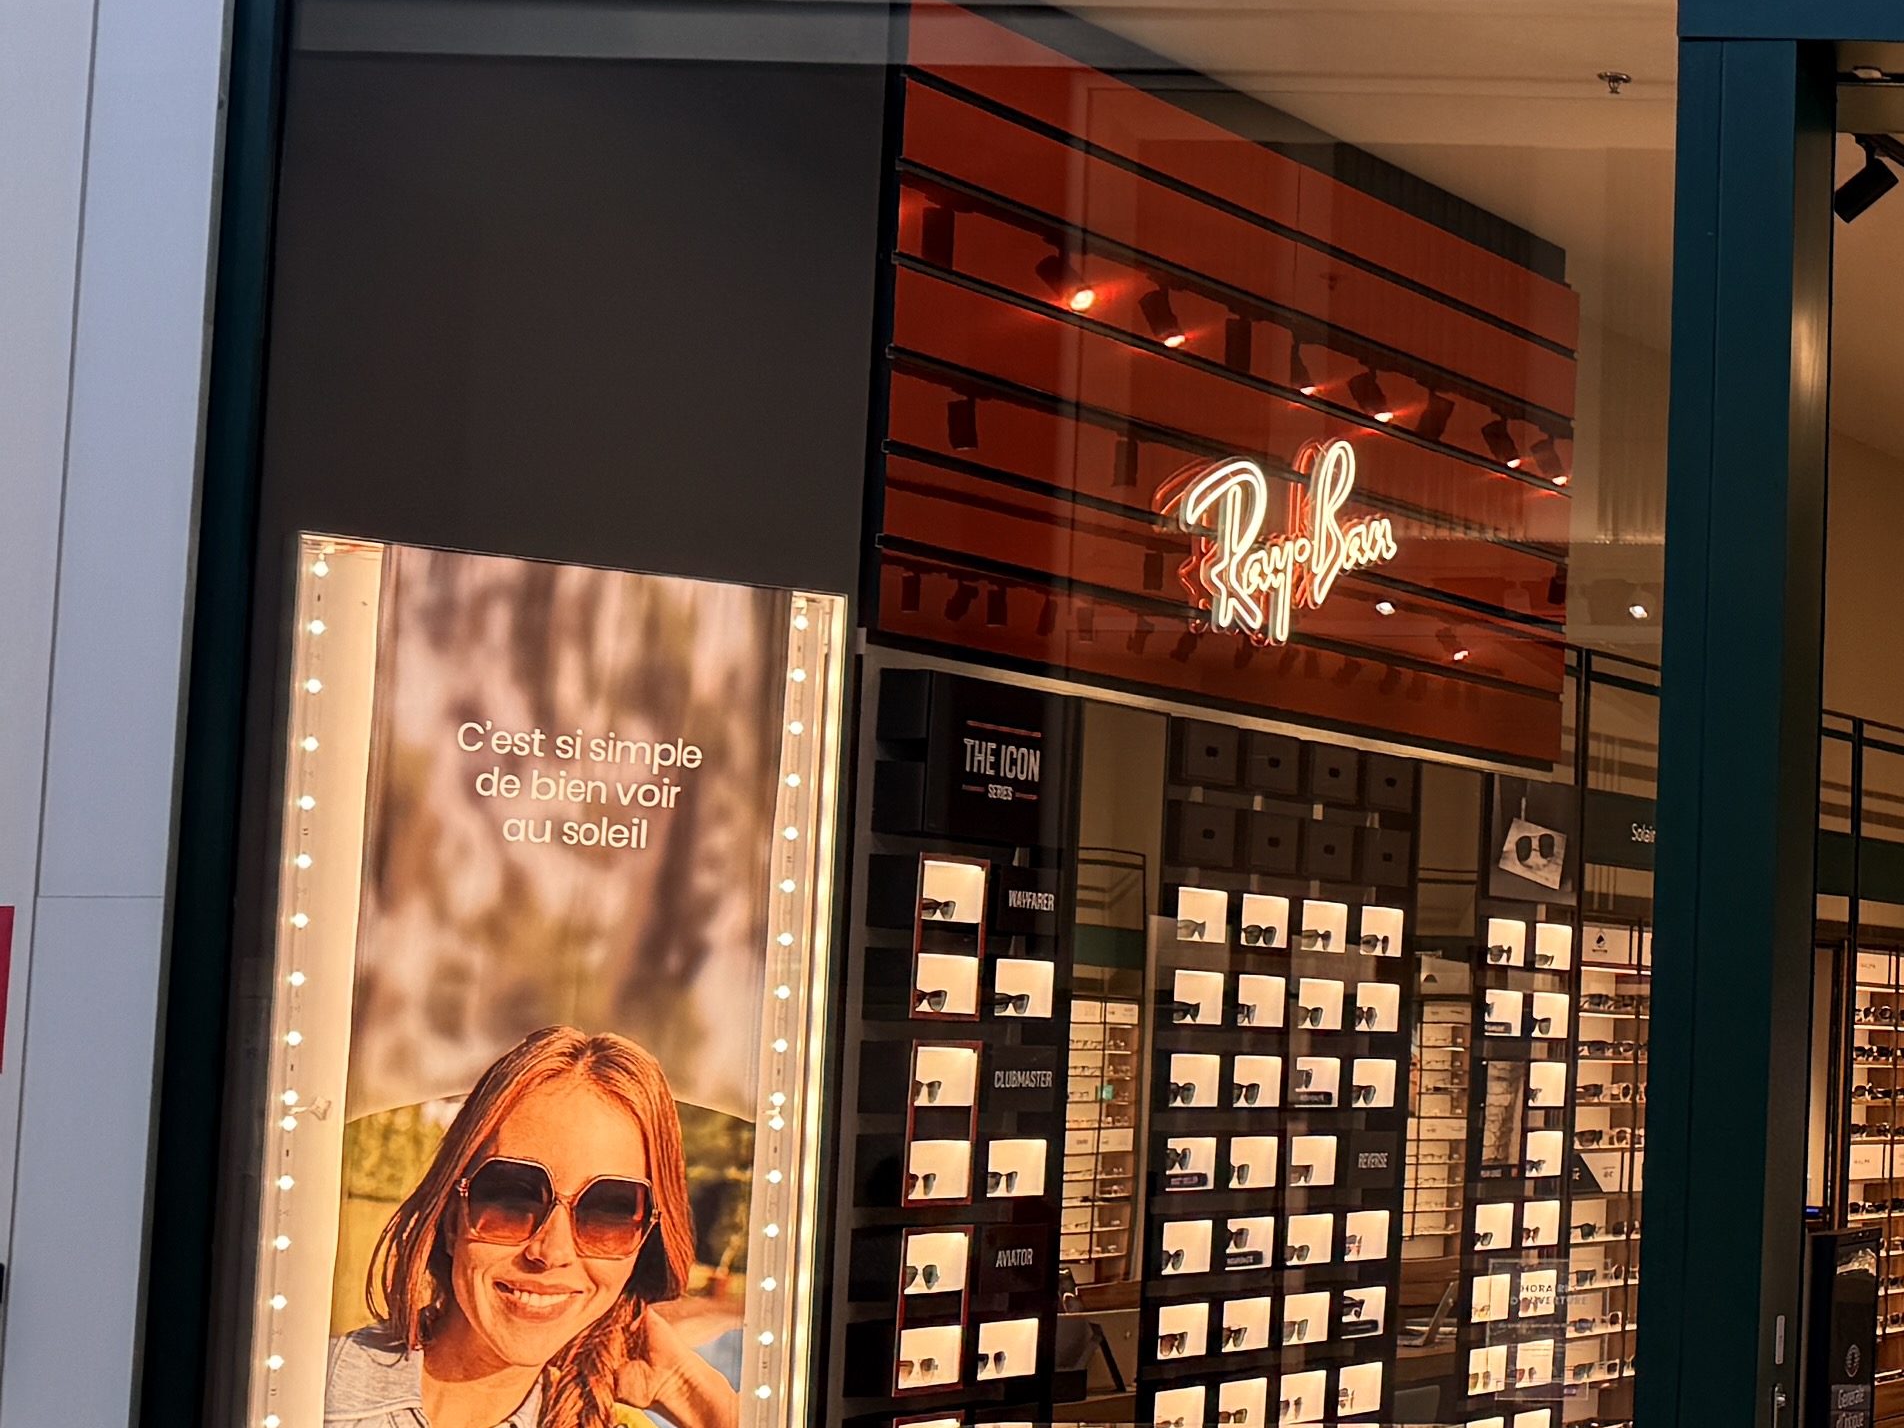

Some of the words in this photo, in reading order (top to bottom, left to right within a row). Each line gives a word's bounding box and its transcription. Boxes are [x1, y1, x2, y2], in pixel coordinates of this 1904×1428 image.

[457, 720, 546, 758] C'est
[555, 729, 583, 760] si
[589, 732, 703, 775] simple
[963, 738, 997, 775] THE
[1000, 745, 1041, 782] ICON
[475, 766, 521, 799] de
[531, 770, 607, 804] bien
[616, 778, 682, 808] voir
[502, 818, 552, 843] au
[562, 817, 648, 849] soleil
[1008, 890, 1055, 911] WAYFARER
[994, 1070, 1053, 1088] CLUBMASTER
[995, 1248, 1033, 1268] AVIATOR
